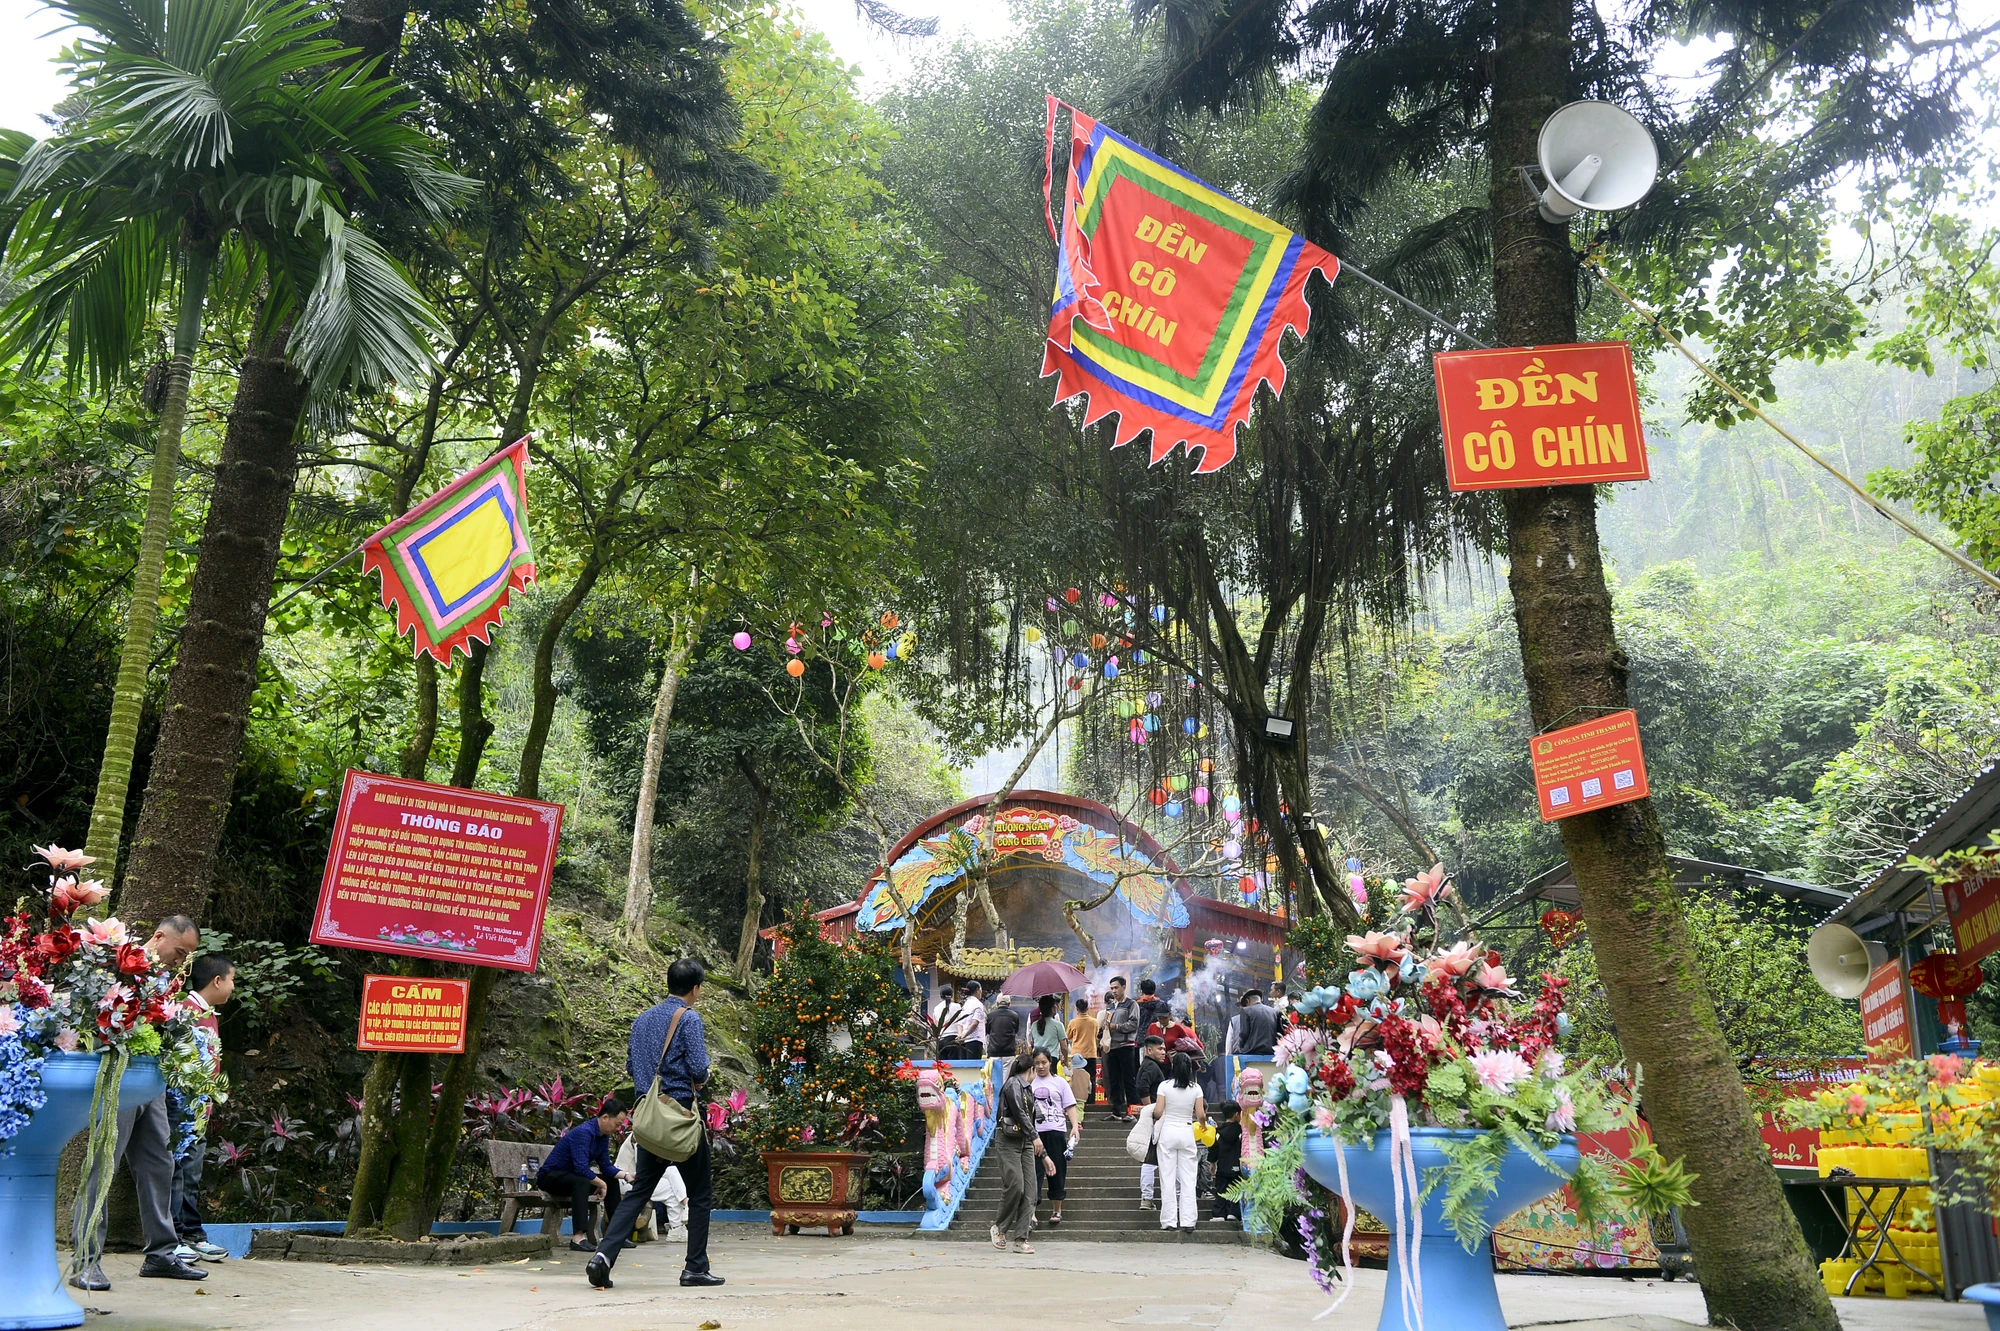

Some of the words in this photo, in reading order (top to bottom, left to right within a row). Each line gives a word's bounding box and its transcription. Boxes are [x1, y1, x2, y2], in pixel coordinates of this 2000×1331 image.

[1134, 214, 1208, 264] ĐỀN
[1128, 260, 1177, 297] CÔ
[1101, 290, 1178, 346] CHÍN
[1476, 358, 1598, 410] ĐỀN
[1463, 420, 1515, 472] CÔ
[1532, 416, 1627, 467] CHÍN
[401, 813, 460, 832] THÔNG
[466, 823, 502, 839] BÁO
[368, 1000, 380, 1014] CÁC
[381, 999, 391, 1015] ĐỐI
[393, 1003, 412, 1018] TƯỢNG
[426, 1005, 441, 1017] THAY
[442, 1004, 451, 1017] VÁI
[392, 984, 442, 1000] CẤM
